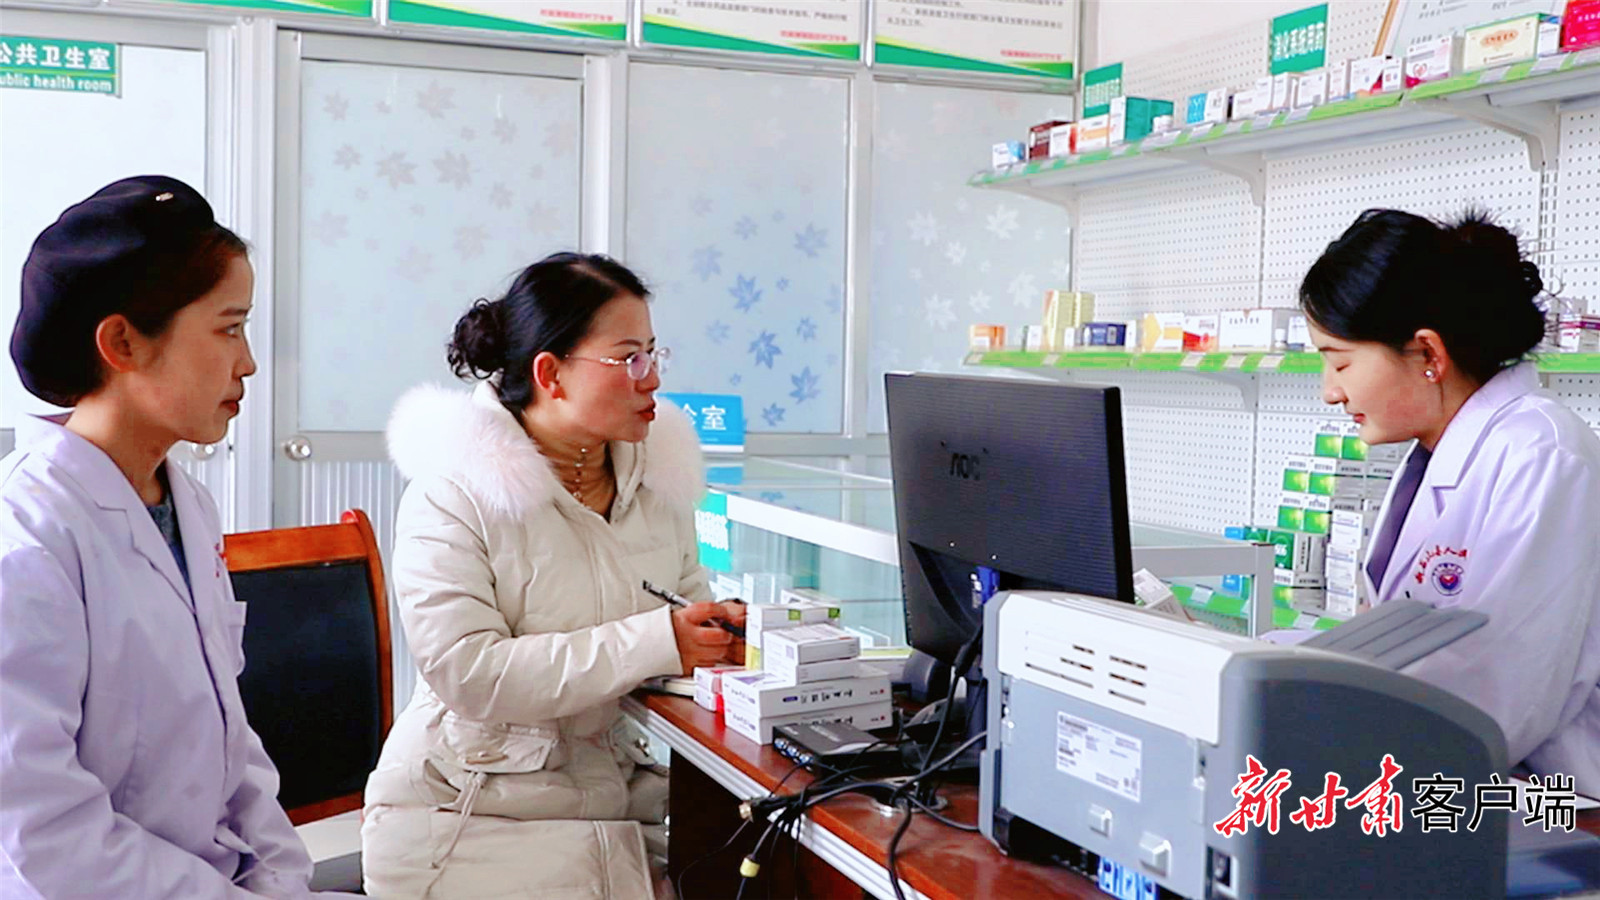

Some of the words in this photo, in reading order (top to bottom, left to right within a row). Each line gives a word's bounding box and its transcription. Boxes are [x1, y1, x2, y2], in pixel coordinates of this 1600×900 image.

[0, 42, 111, 70] 公共卫生室
[33, 74, 75, 90] health
[78, 79, 112, 92] room
